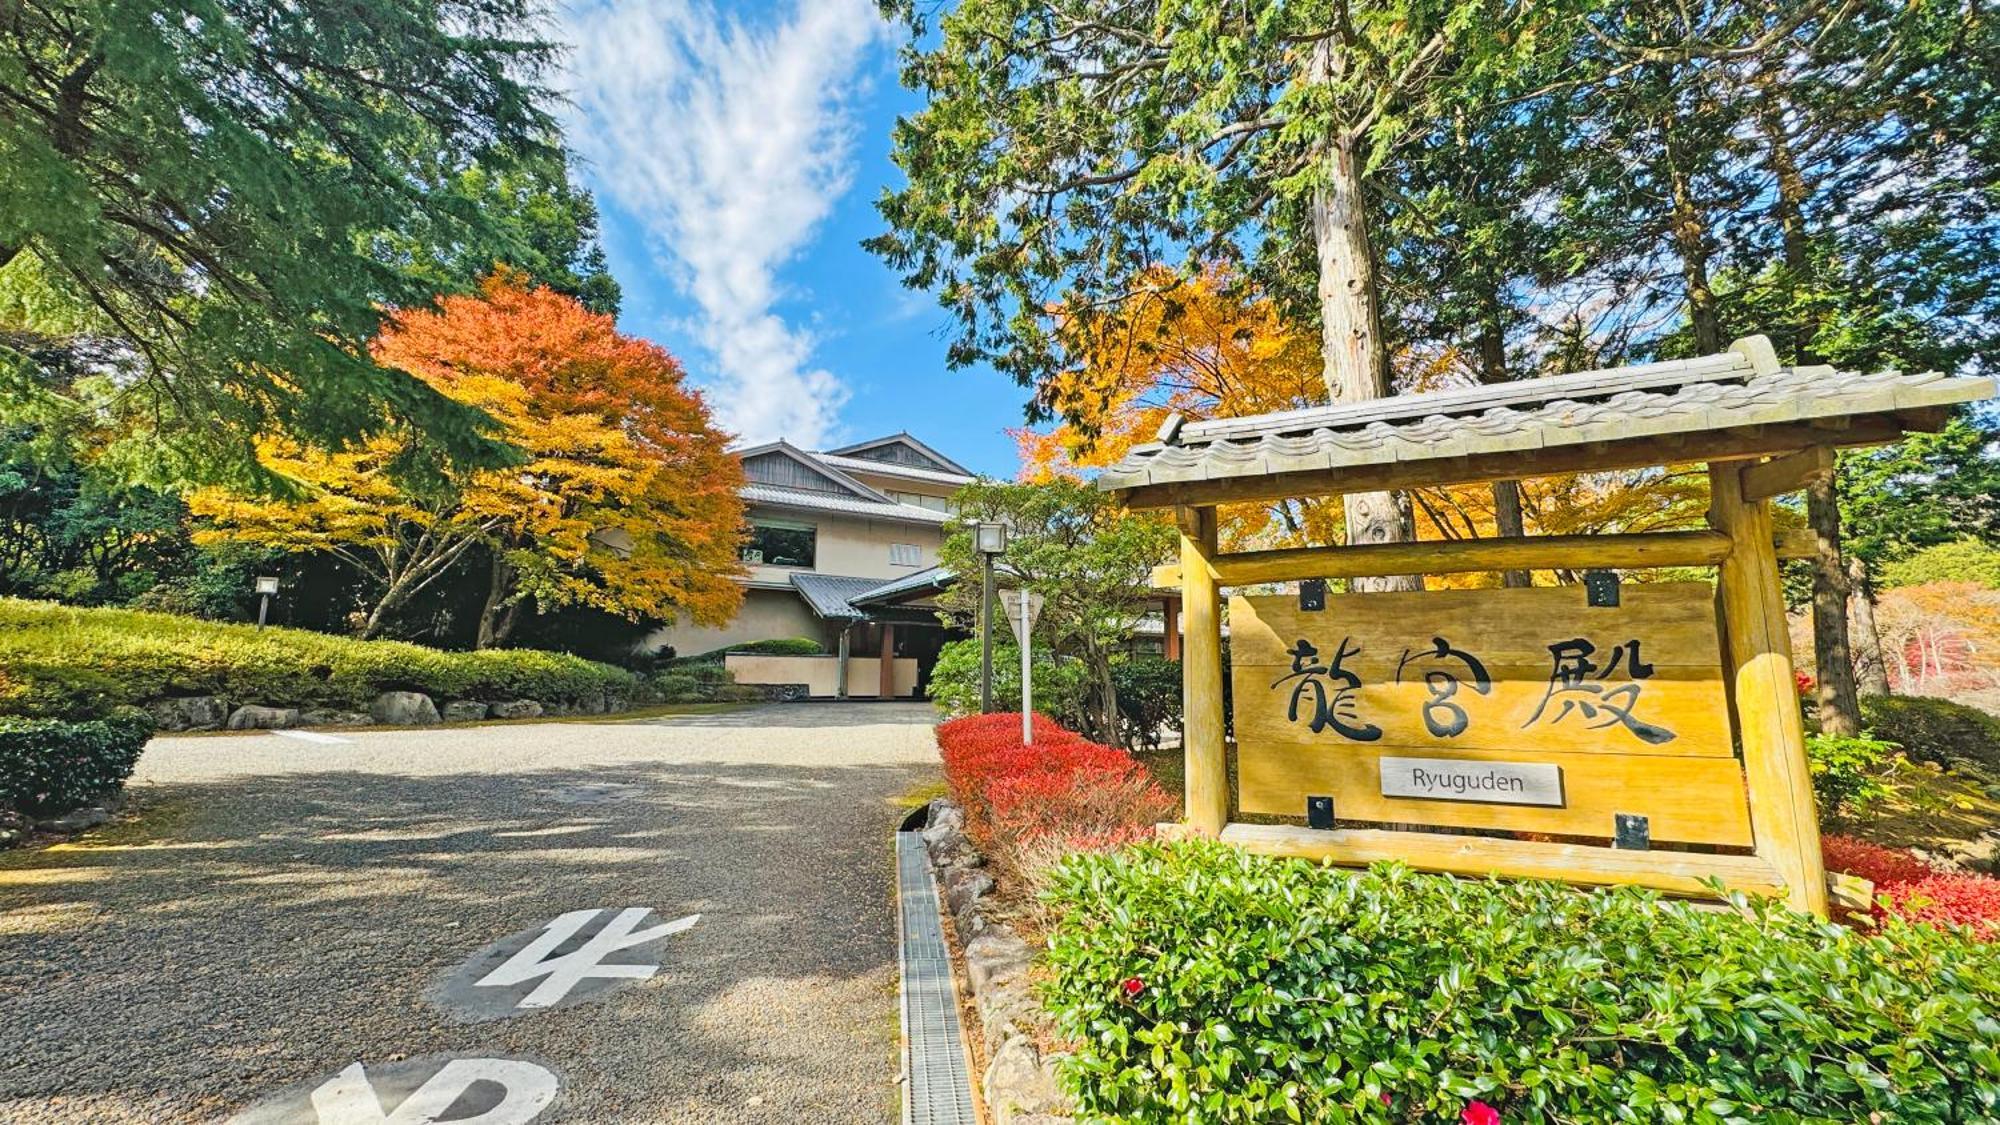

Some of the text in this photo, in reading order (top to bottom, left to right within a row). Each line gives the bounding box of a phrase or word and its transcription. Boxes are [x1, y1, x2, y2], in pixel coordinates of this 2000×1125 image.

[1271, 636, 1677, 743] 龍宮殿
[1412, 767, 1524, 794] Ryuguden
